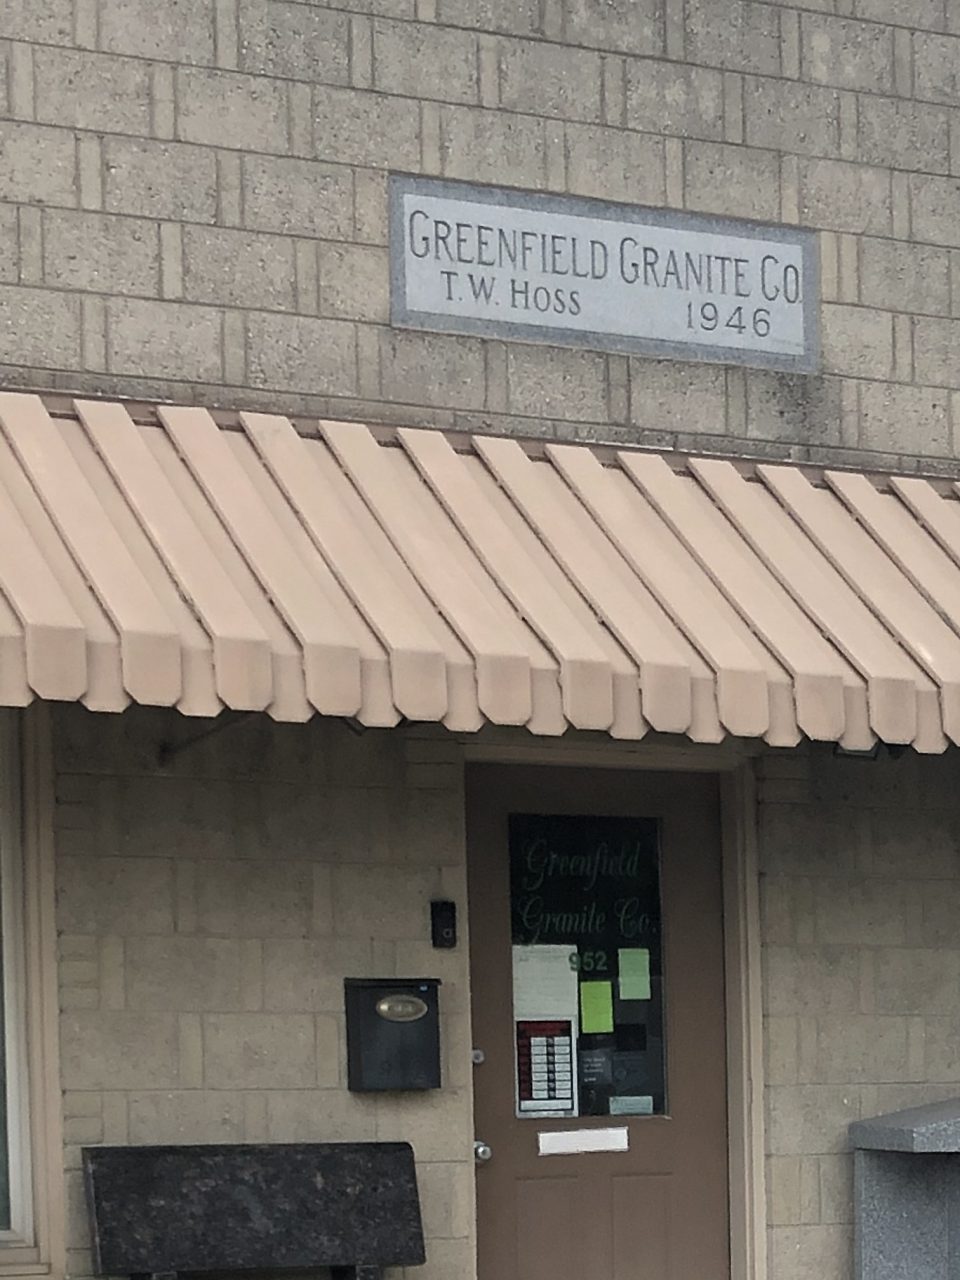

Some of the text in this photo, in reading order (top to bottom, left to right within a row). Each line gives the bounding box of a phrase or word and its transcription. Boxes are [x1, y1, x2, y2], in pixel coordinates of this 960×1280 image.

[409, 210, 608, 279] GREENFIELD
[619, 237, 751, 297] GRANITE
[510, 281, 582, 316] HOSS
[686, 302, 772, 337] 1946
[523, 838, 641, 892] Greenfield
[517, 896, 606, 944] Granite
[569, 951, 608, 971] 952
